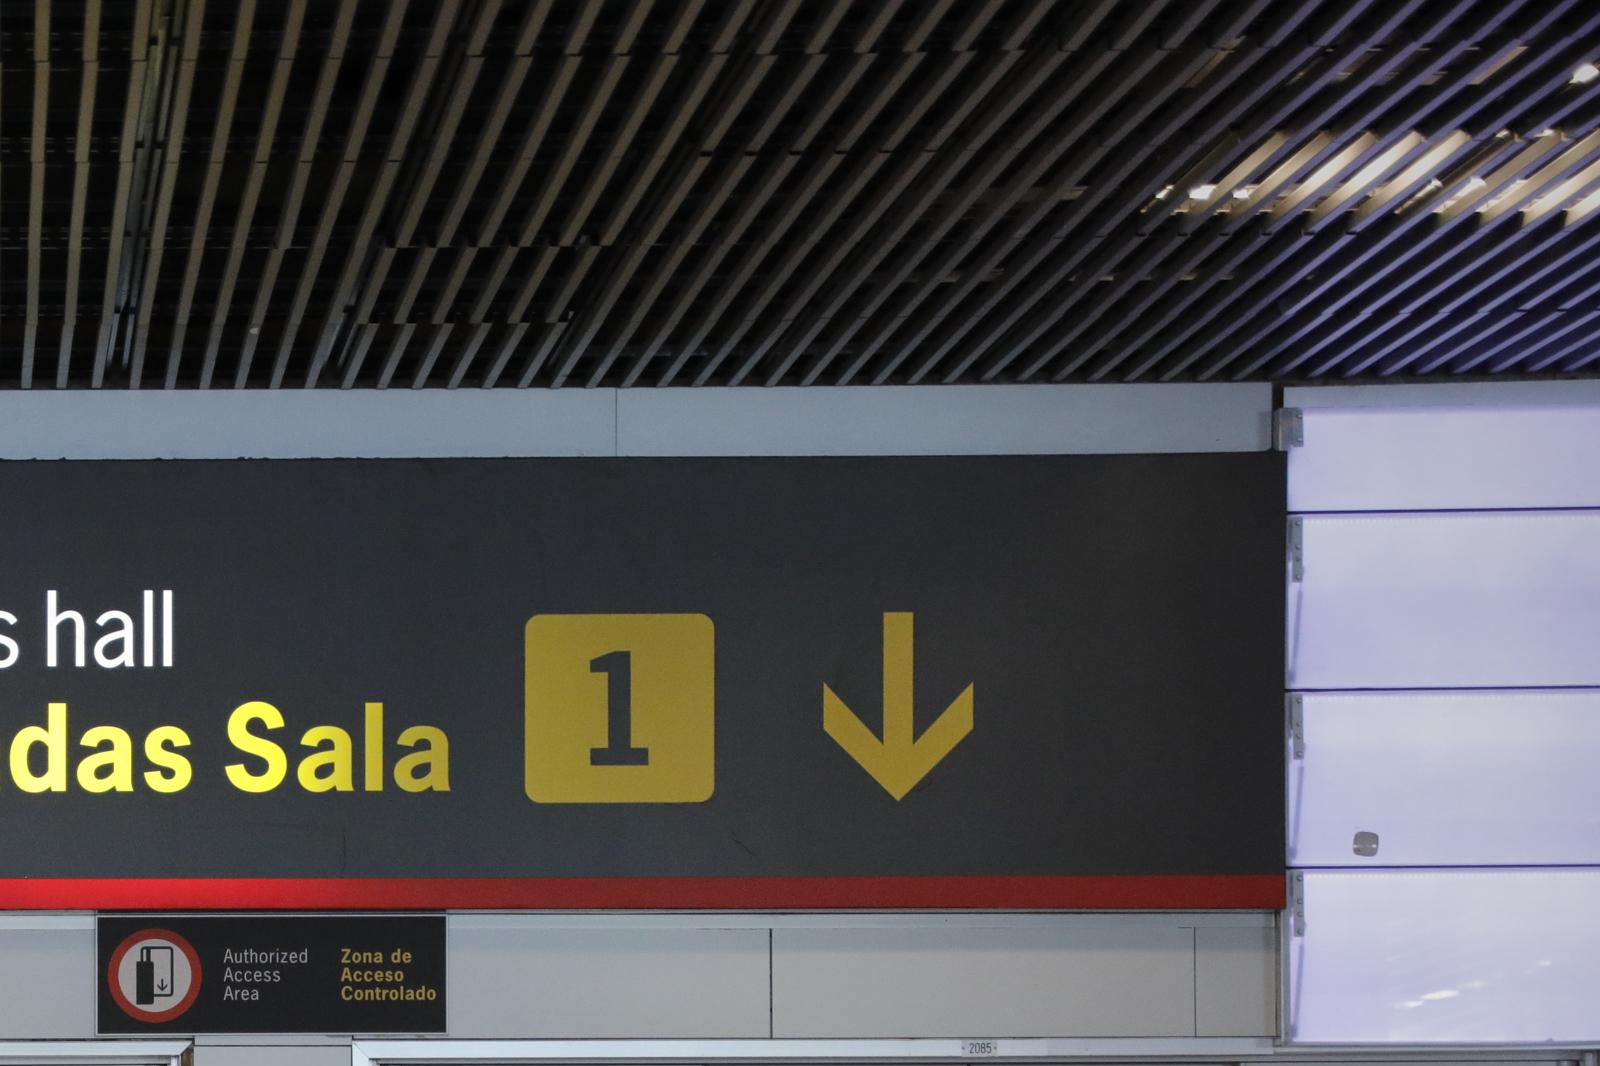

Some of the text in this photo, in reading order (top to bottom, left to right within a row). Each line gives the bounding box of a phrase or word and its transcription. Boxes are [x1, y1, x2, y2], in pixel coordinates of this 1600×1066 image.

[46, 587, 175, 671] hall
[588, 649, 650, 767] 1
[223, 699, 452, 795] Sala
[223, 947, 308, 964] Authorized
[340, 948, 412, 964] Zona de
[223, 966, 281, 983] Access
[340, 966, 404, 983] Acceso
[223, 985, 259, 1001] Area
[340, 985, 437, 1001] Controlado
[969, 1042, 992, 1054] 2085
